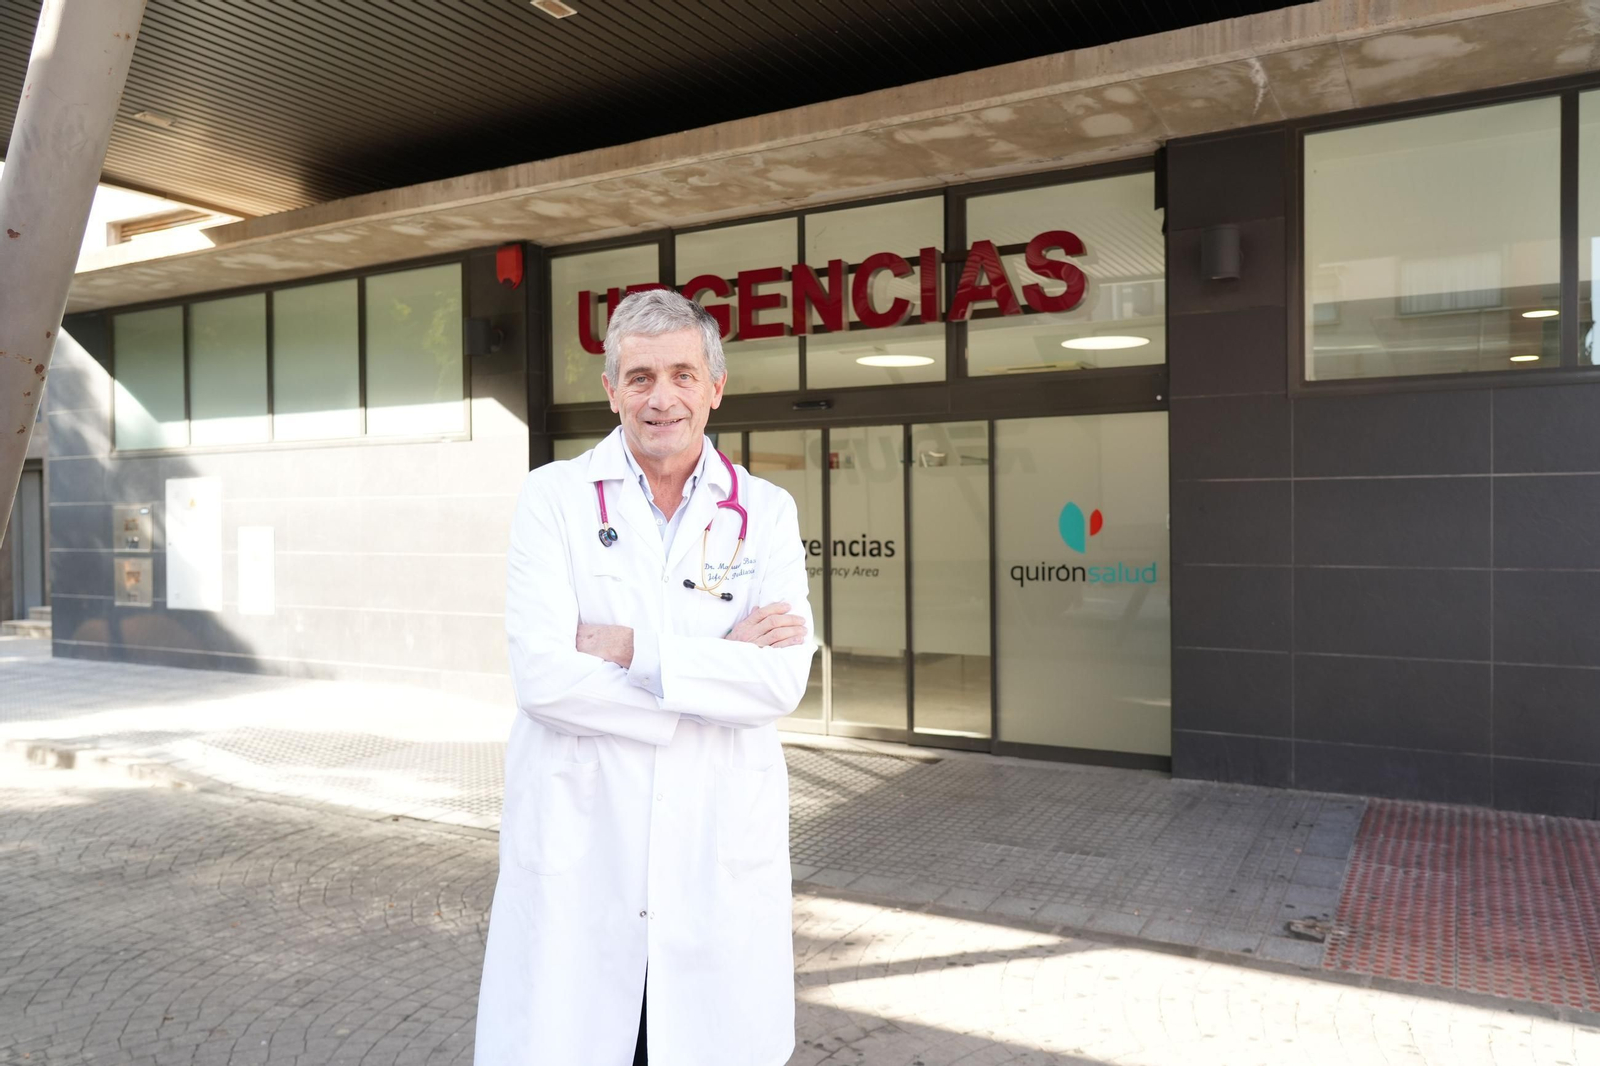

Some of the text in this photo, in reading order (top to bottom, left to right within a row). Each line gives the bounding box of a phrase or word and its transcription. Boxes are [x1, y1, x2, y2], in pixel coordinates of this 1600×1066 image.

[578, 230, 1087, 355] UGENCIAS
[852, 566, 879, 577] Area
[1010, 561, 1157, 588] quirónsalud
